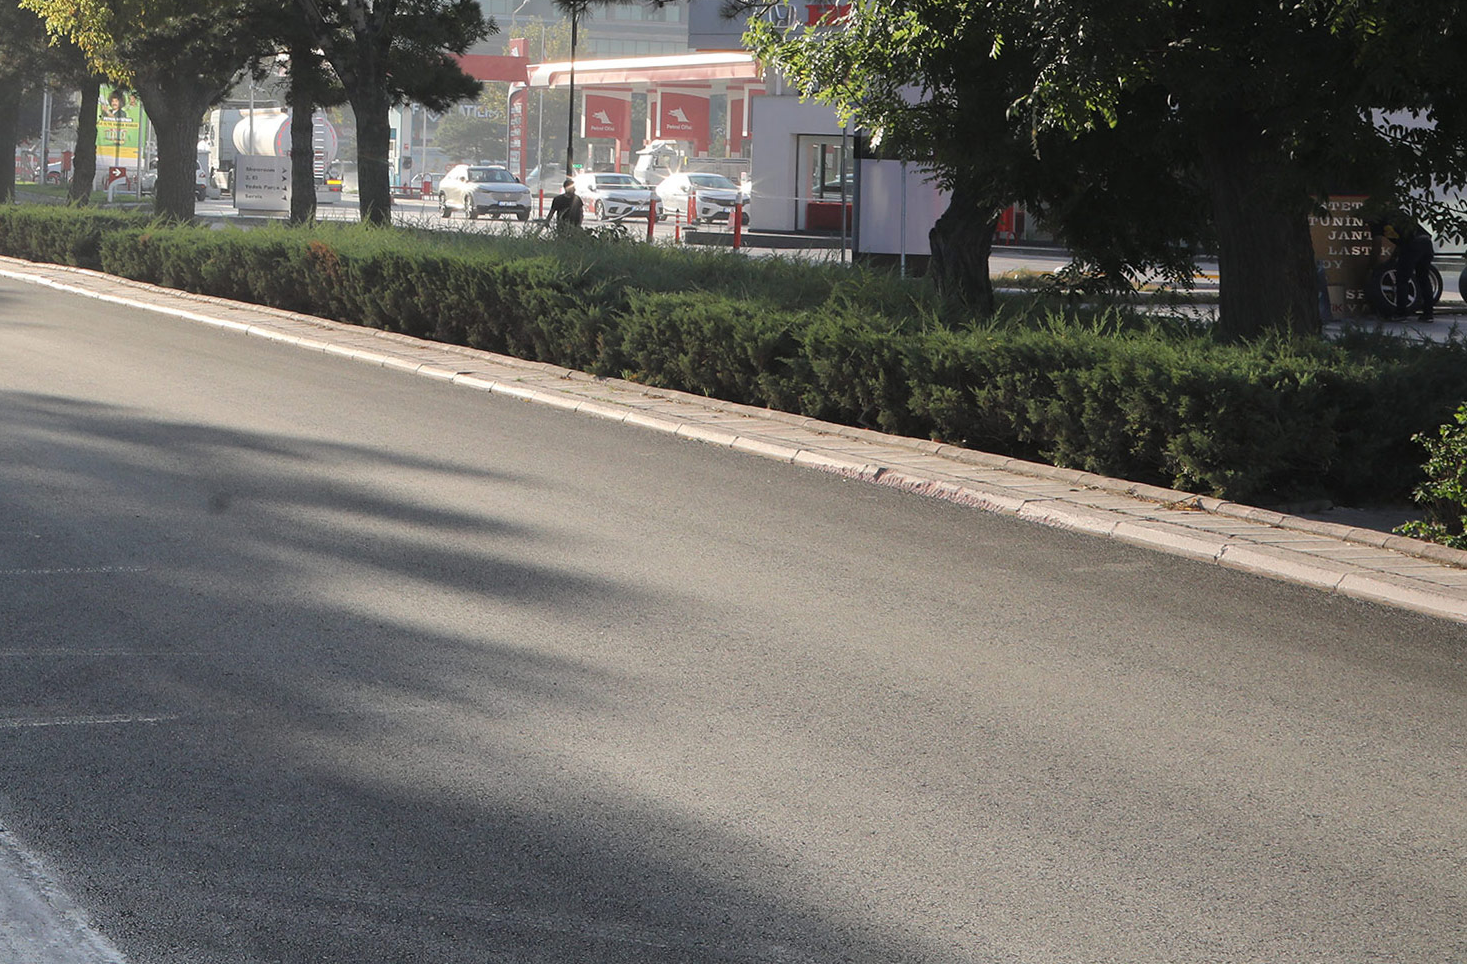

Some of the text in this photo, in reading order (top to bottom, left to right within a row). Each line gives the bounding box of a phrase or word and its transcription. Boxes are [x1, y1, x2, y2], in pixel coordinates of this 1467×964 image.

[1307, 215, 1369, 227] TUNİN
[1327, 230, 1373, 241] JANT
[1328, 246, 1392, 256] LASTK
